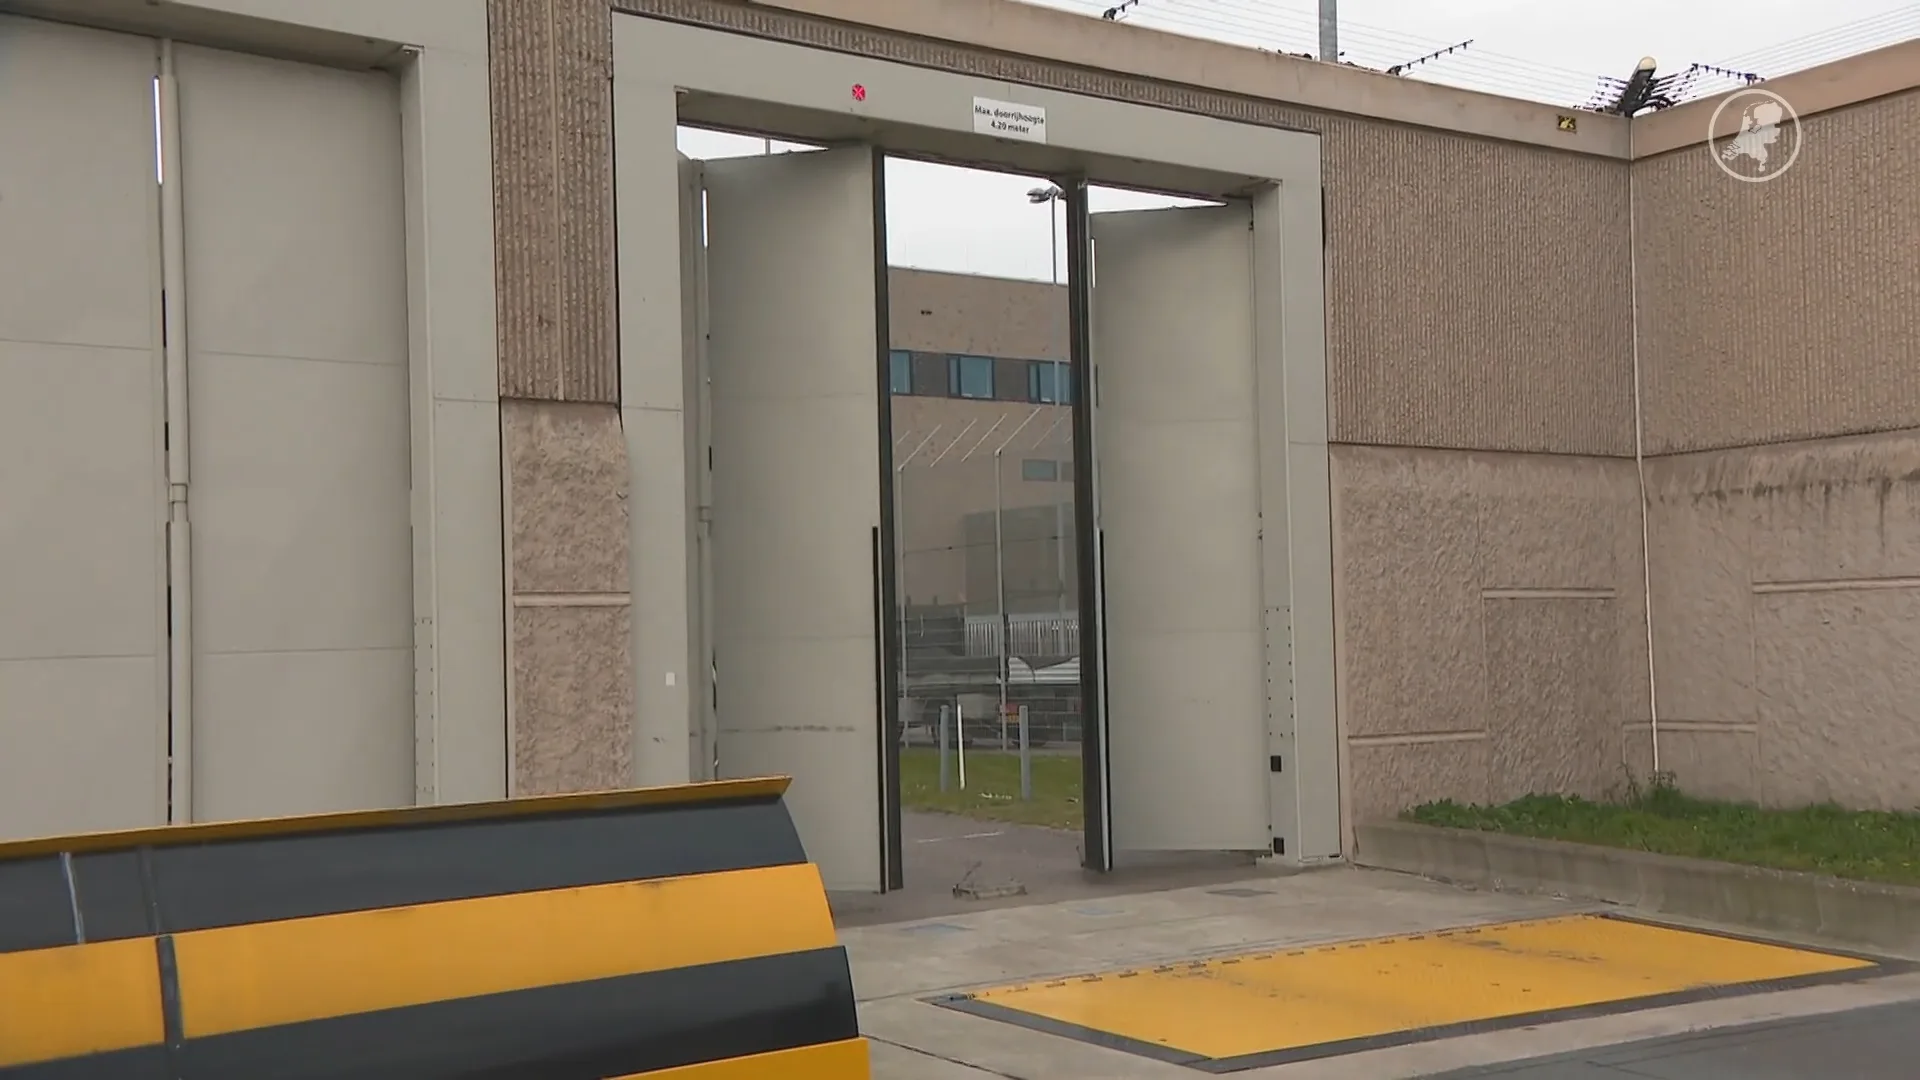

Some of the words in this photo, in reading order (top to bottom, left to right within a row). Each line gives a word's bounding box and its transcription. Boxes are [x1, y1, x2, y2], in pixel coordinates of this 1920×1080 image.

[975, 105, 992, 116] Max.
[994, 108, 1044, 125] doorrijhoogte
[1008, 124, 1030, 134] meter
